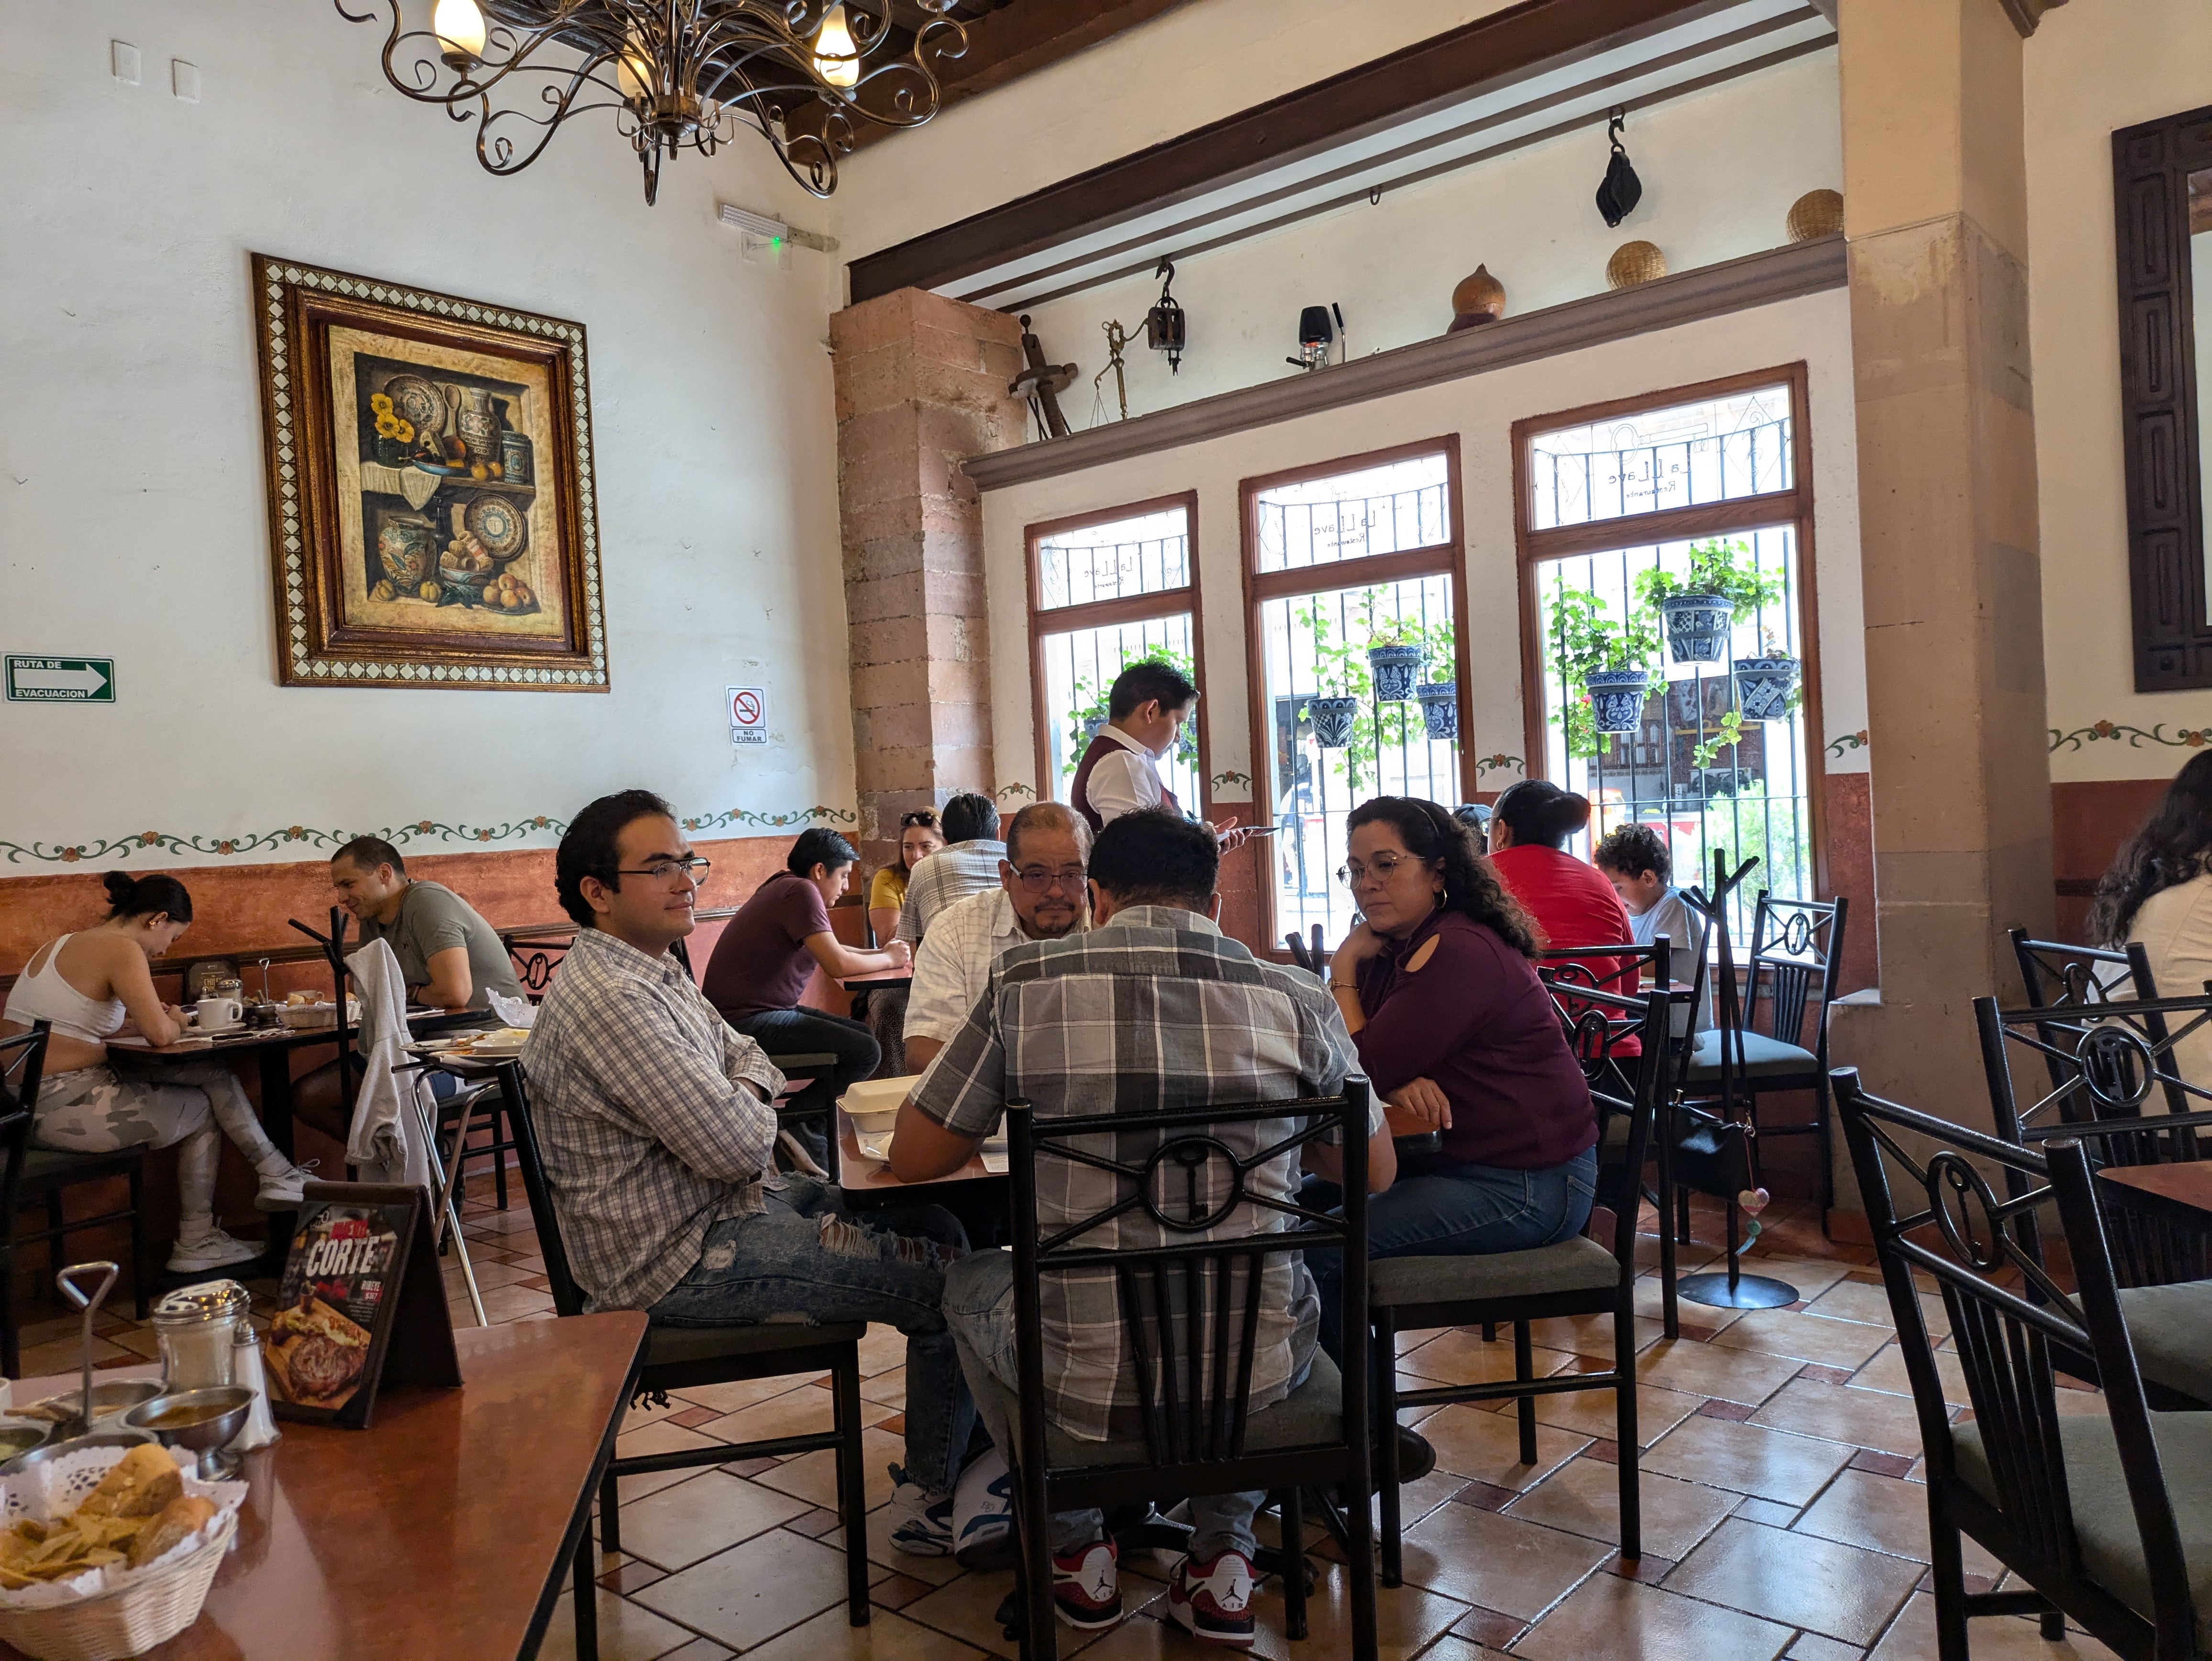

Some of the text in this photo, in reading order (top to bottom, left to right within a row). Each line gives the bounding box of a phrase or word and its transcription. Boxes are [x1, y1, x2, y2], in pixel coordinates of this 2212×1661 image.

[13, 660, 44, 668] RUTA
[15, 689, 85, 698] EVACUACION
[306, 1236, 380, 1277] CORTE
[1094, 1589, 1114, 1600] AIR
